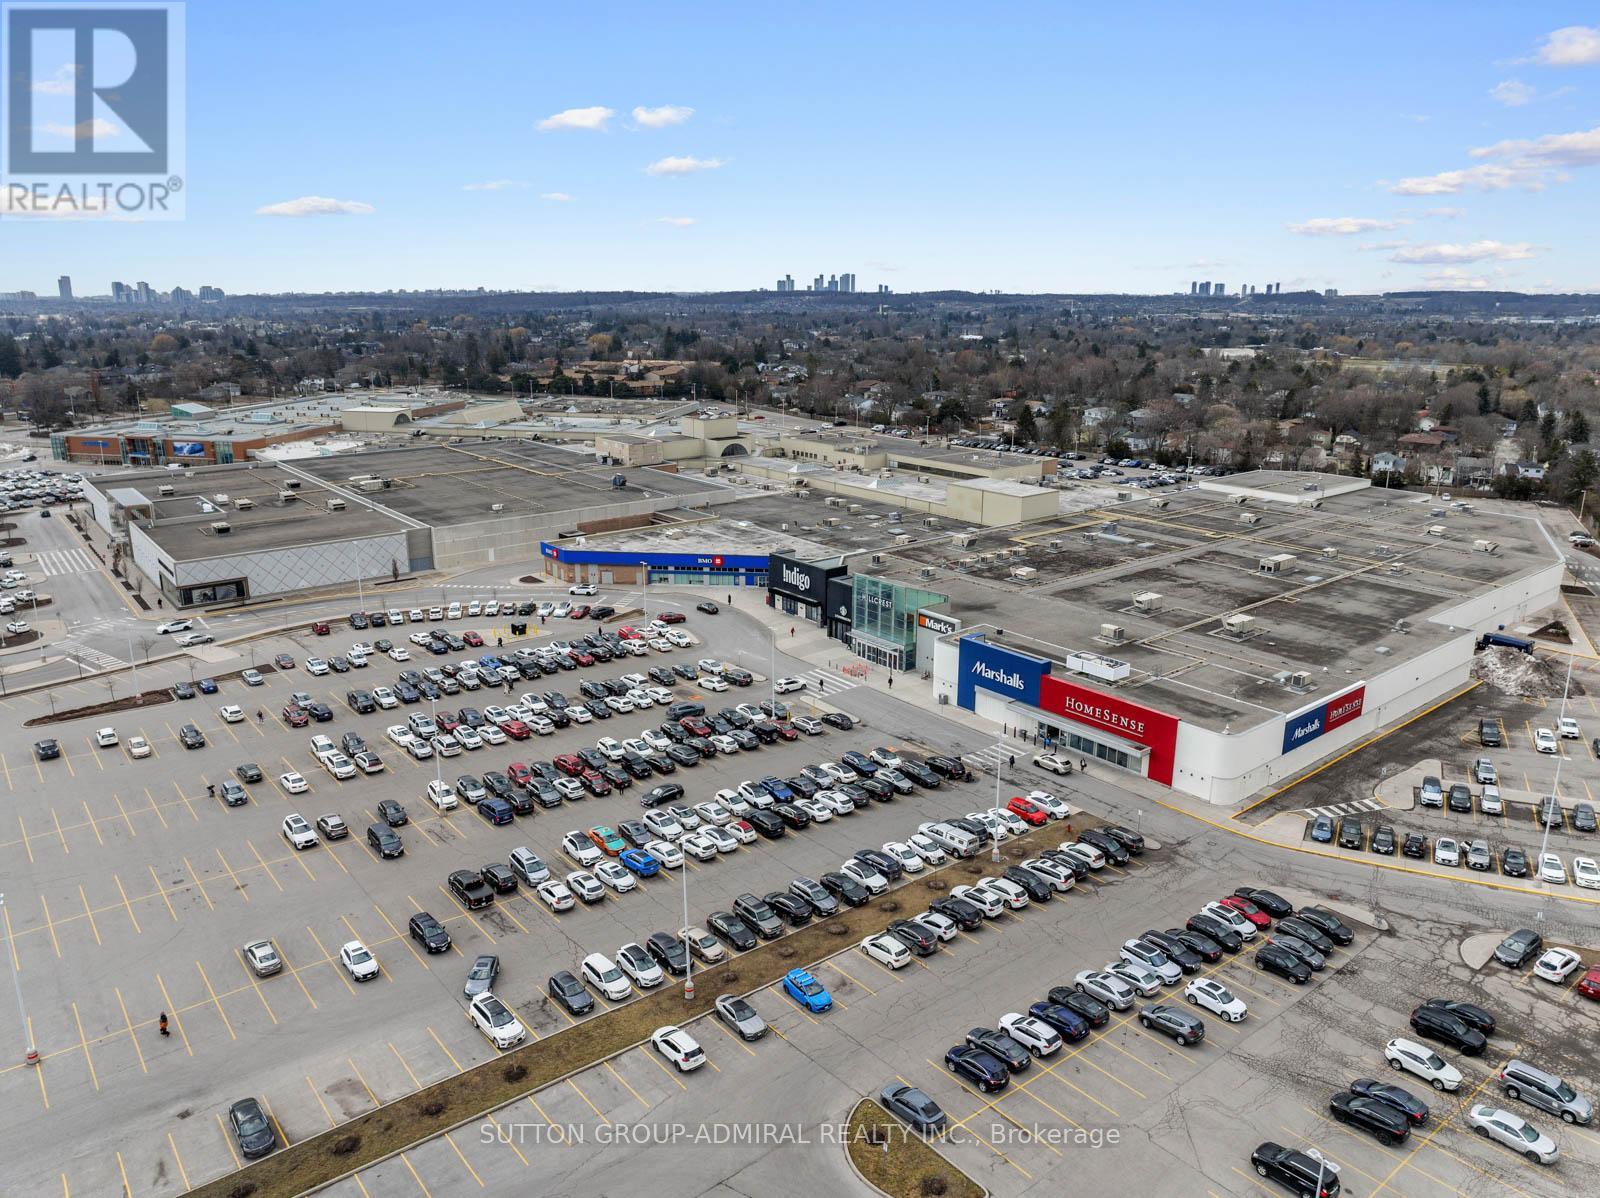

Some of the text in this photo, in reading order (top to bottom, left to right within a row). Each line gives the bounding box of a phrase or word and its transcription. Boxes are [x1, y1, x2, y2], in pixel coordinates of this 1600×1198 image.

[783, 563, 810, 591] Indigo
[925, 618, 952, 634] Mark's
[971, 661, 1025, 690] Marshalls
[1291, 718, 1321, 741] Marshalls
